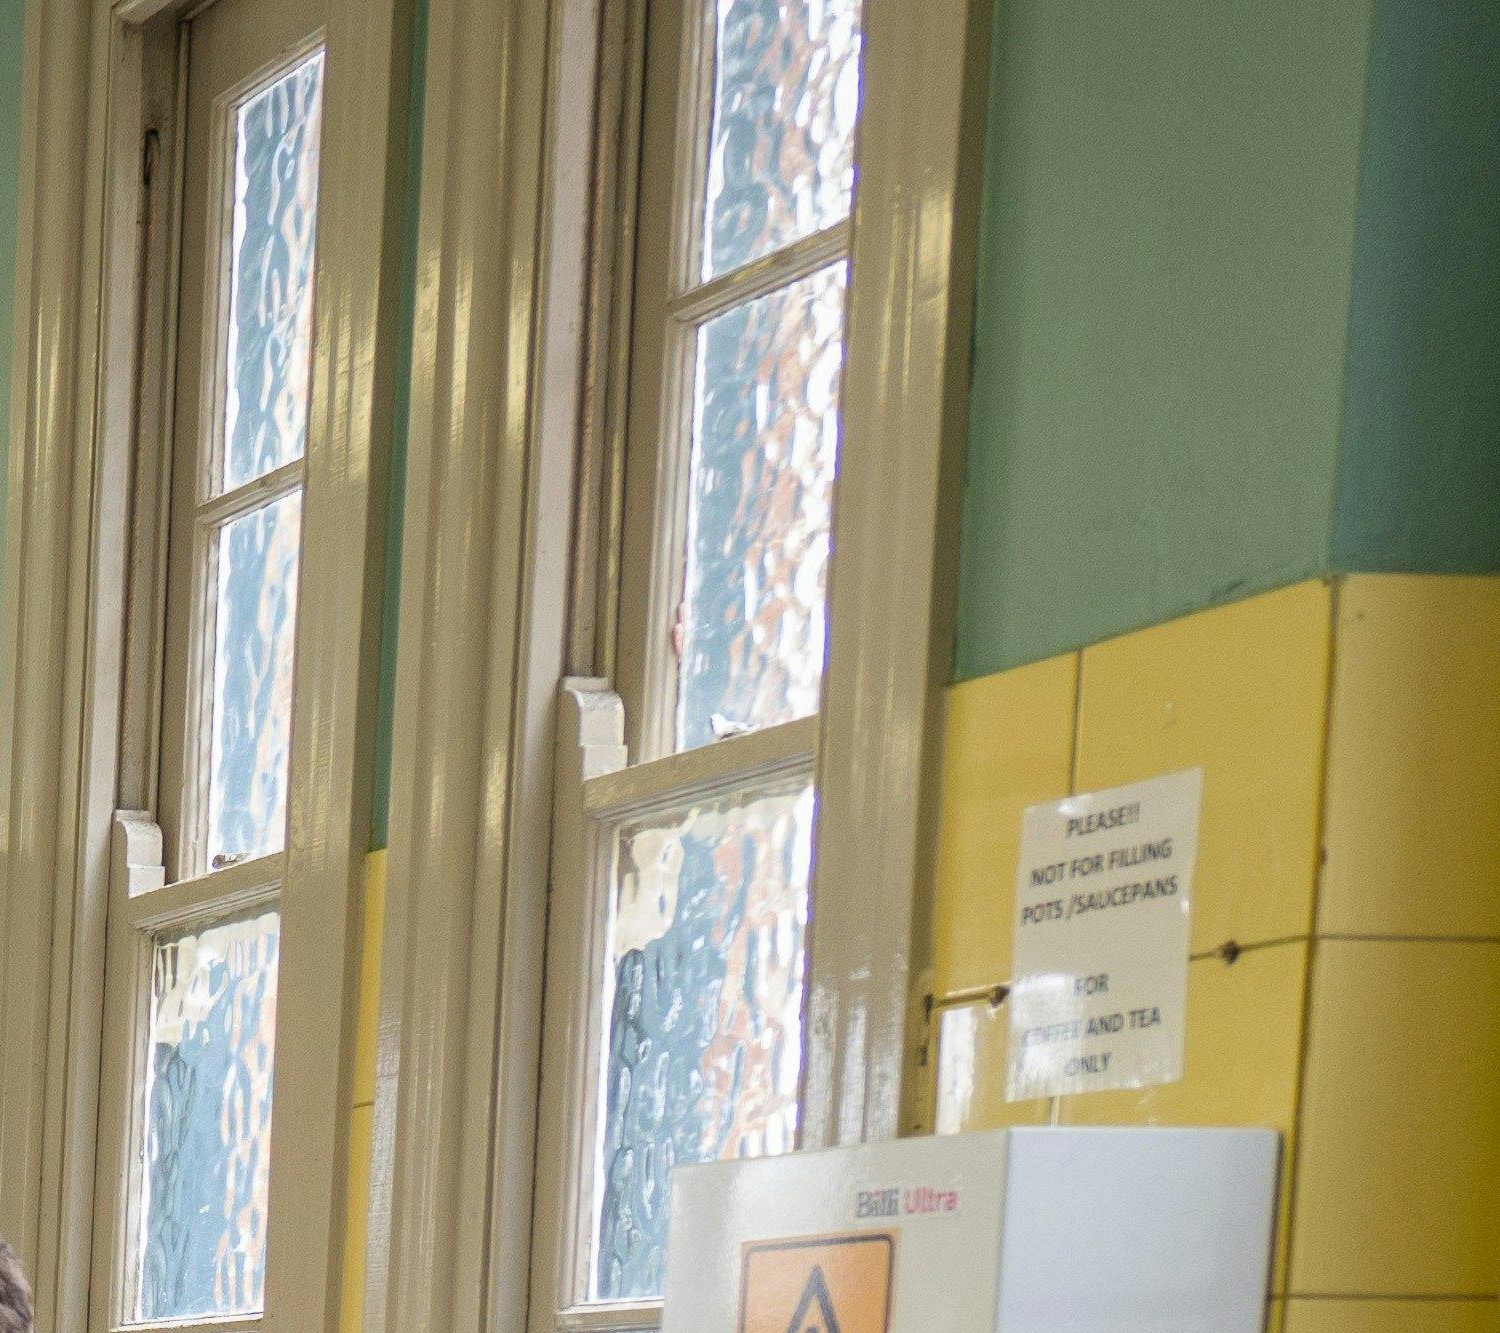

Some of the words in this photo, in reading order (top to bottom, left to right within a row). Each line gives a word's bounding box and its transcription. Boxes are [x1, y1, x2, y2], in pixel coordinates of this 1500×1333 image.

[1030, 862, 1065, 886] NOT
[1070, 854, 1104, 878] FOR
[1108, 837, 1173, 870] FILLING
[1021, 900, 1063, 926] POTS
[1074, 973, 1109, 997] FOR
[1085, 1013, 1124, 1036] AND
[1129, 1006, 1161, 1029] TEA
[1064, 1052, 1112, 1077] ONLY
[903, 1186, 958, 1214] Ultra
